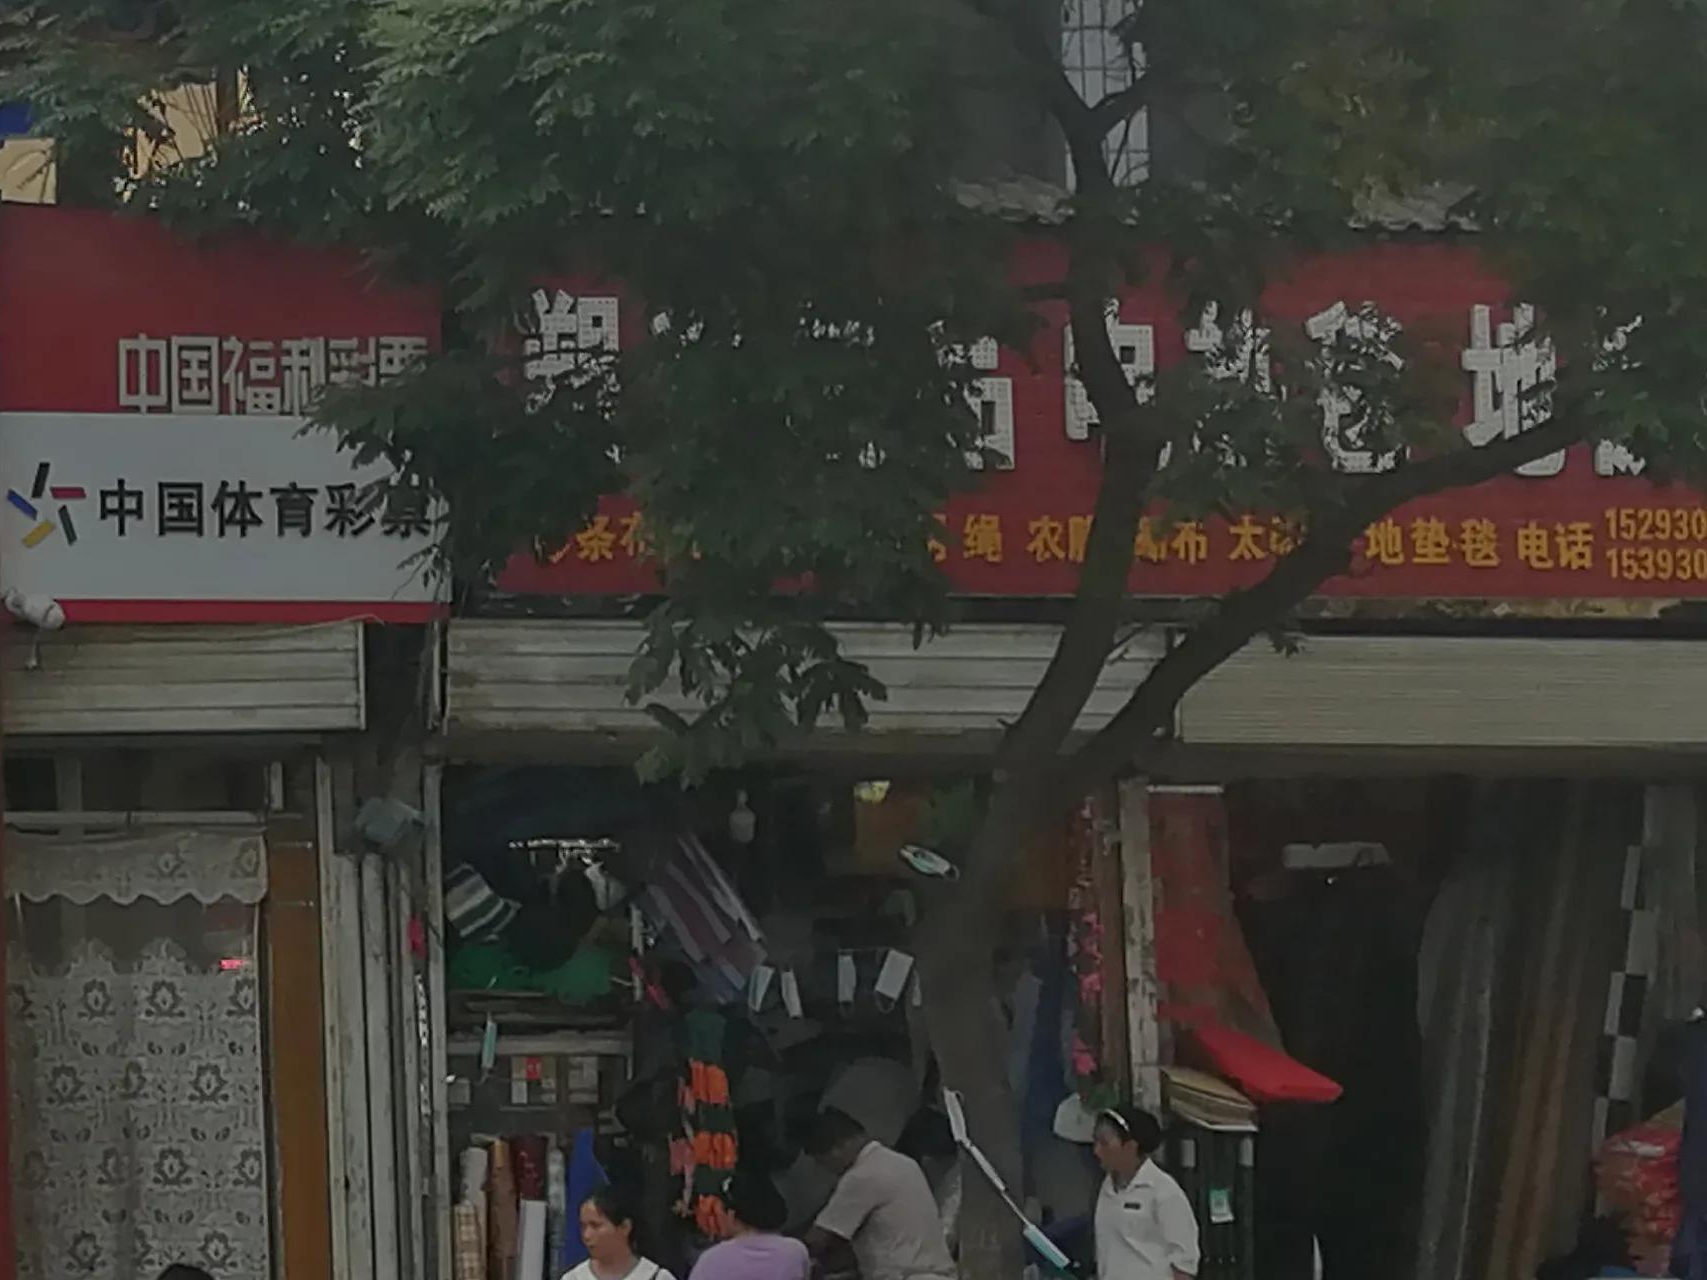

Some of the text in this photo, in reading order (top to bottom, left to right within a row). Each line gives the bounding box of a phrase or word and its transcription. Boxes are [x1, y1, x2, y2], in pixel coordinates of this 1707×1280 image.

[100, 478, 433, 538] 中国体育彩票
[1516, 520, 1595, 571] 电话
